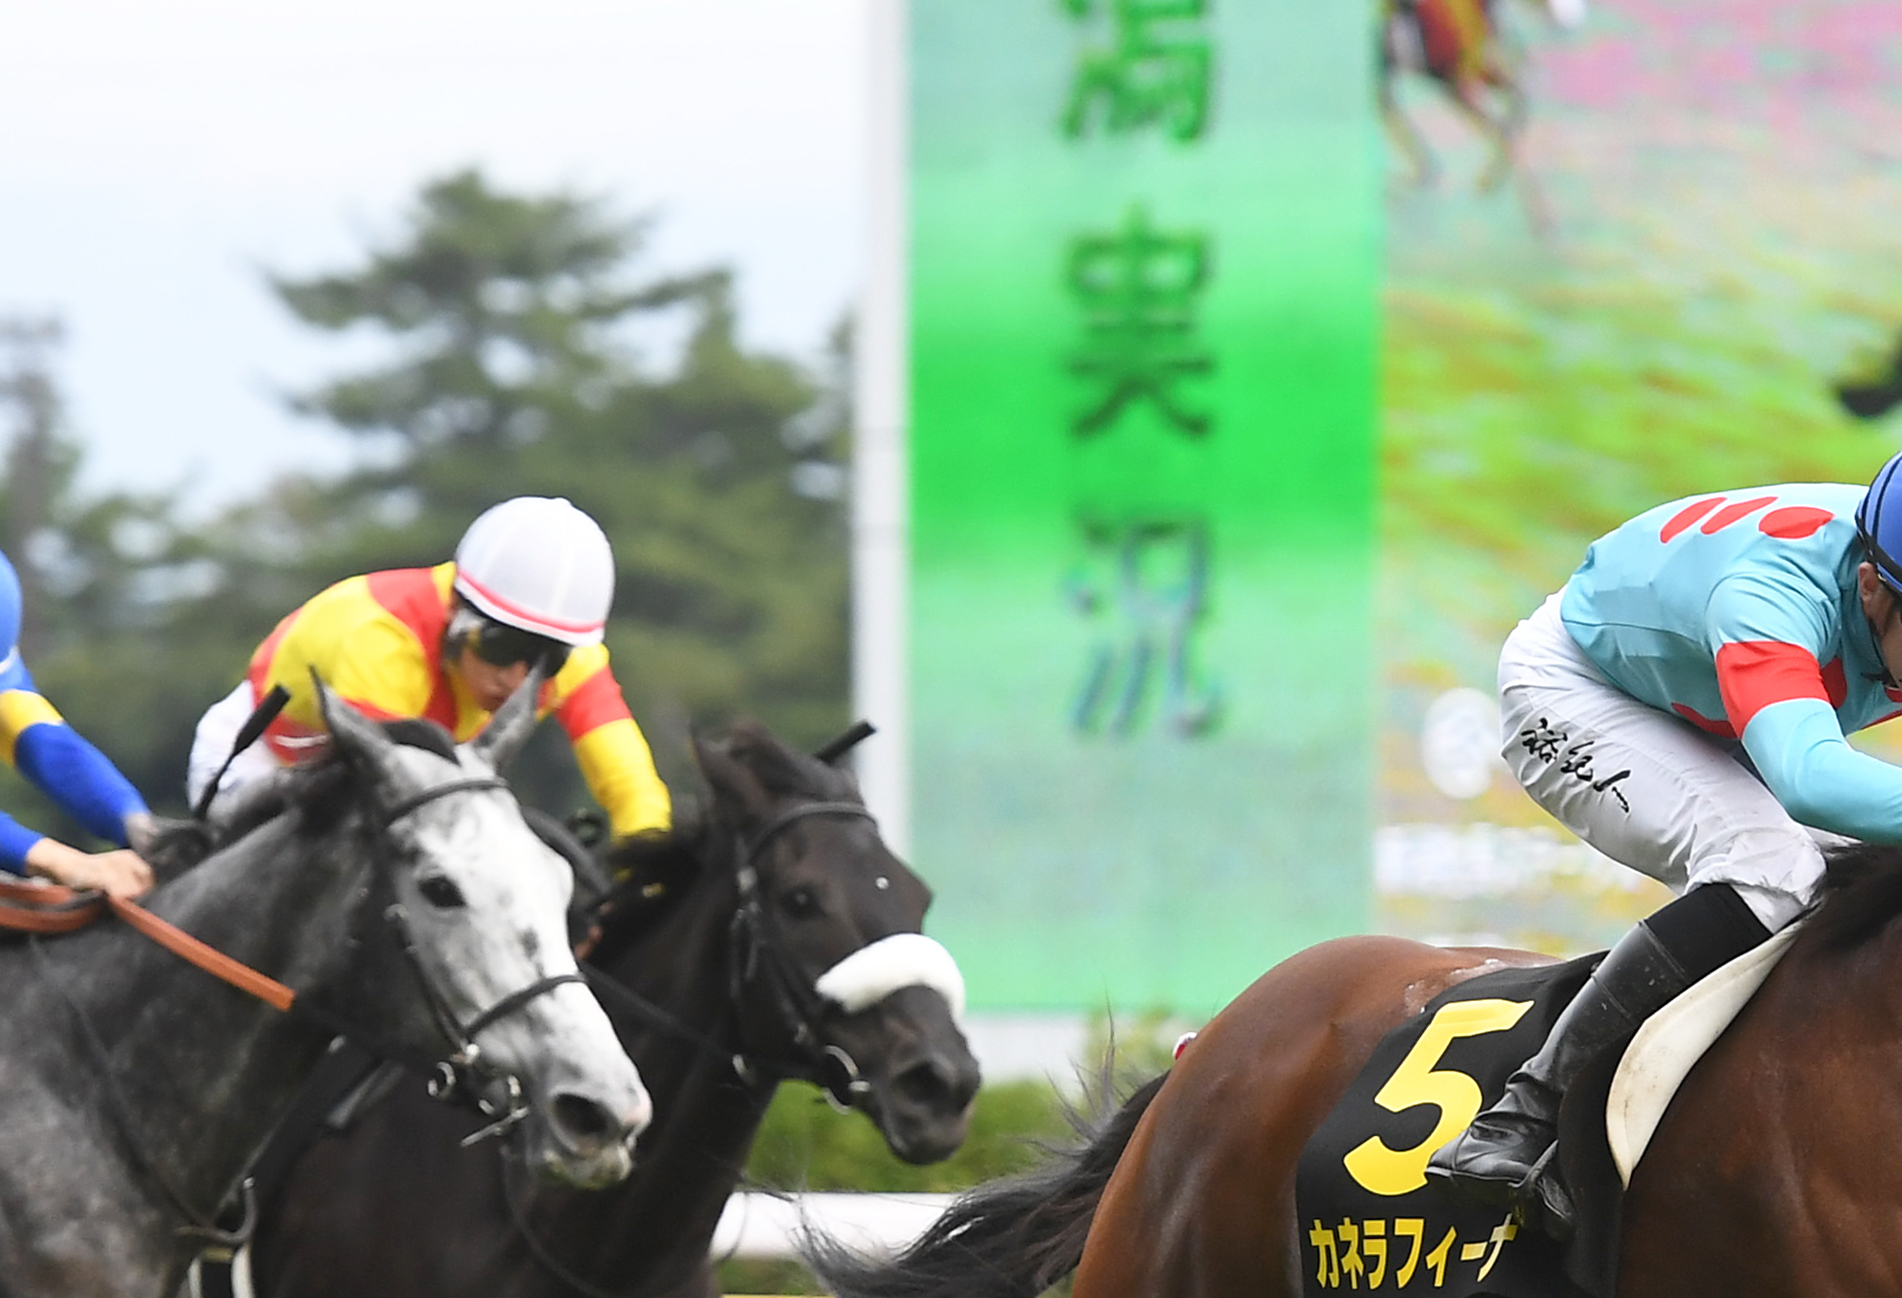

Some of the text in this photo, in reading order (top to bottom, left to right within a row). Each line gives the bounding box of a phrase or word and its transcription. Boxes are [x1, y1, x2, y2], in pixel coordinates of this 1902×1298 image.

[1343, 998, 1535, 1196] 5
[1308, 1212, 1518, 1290] カネラフィーナ
